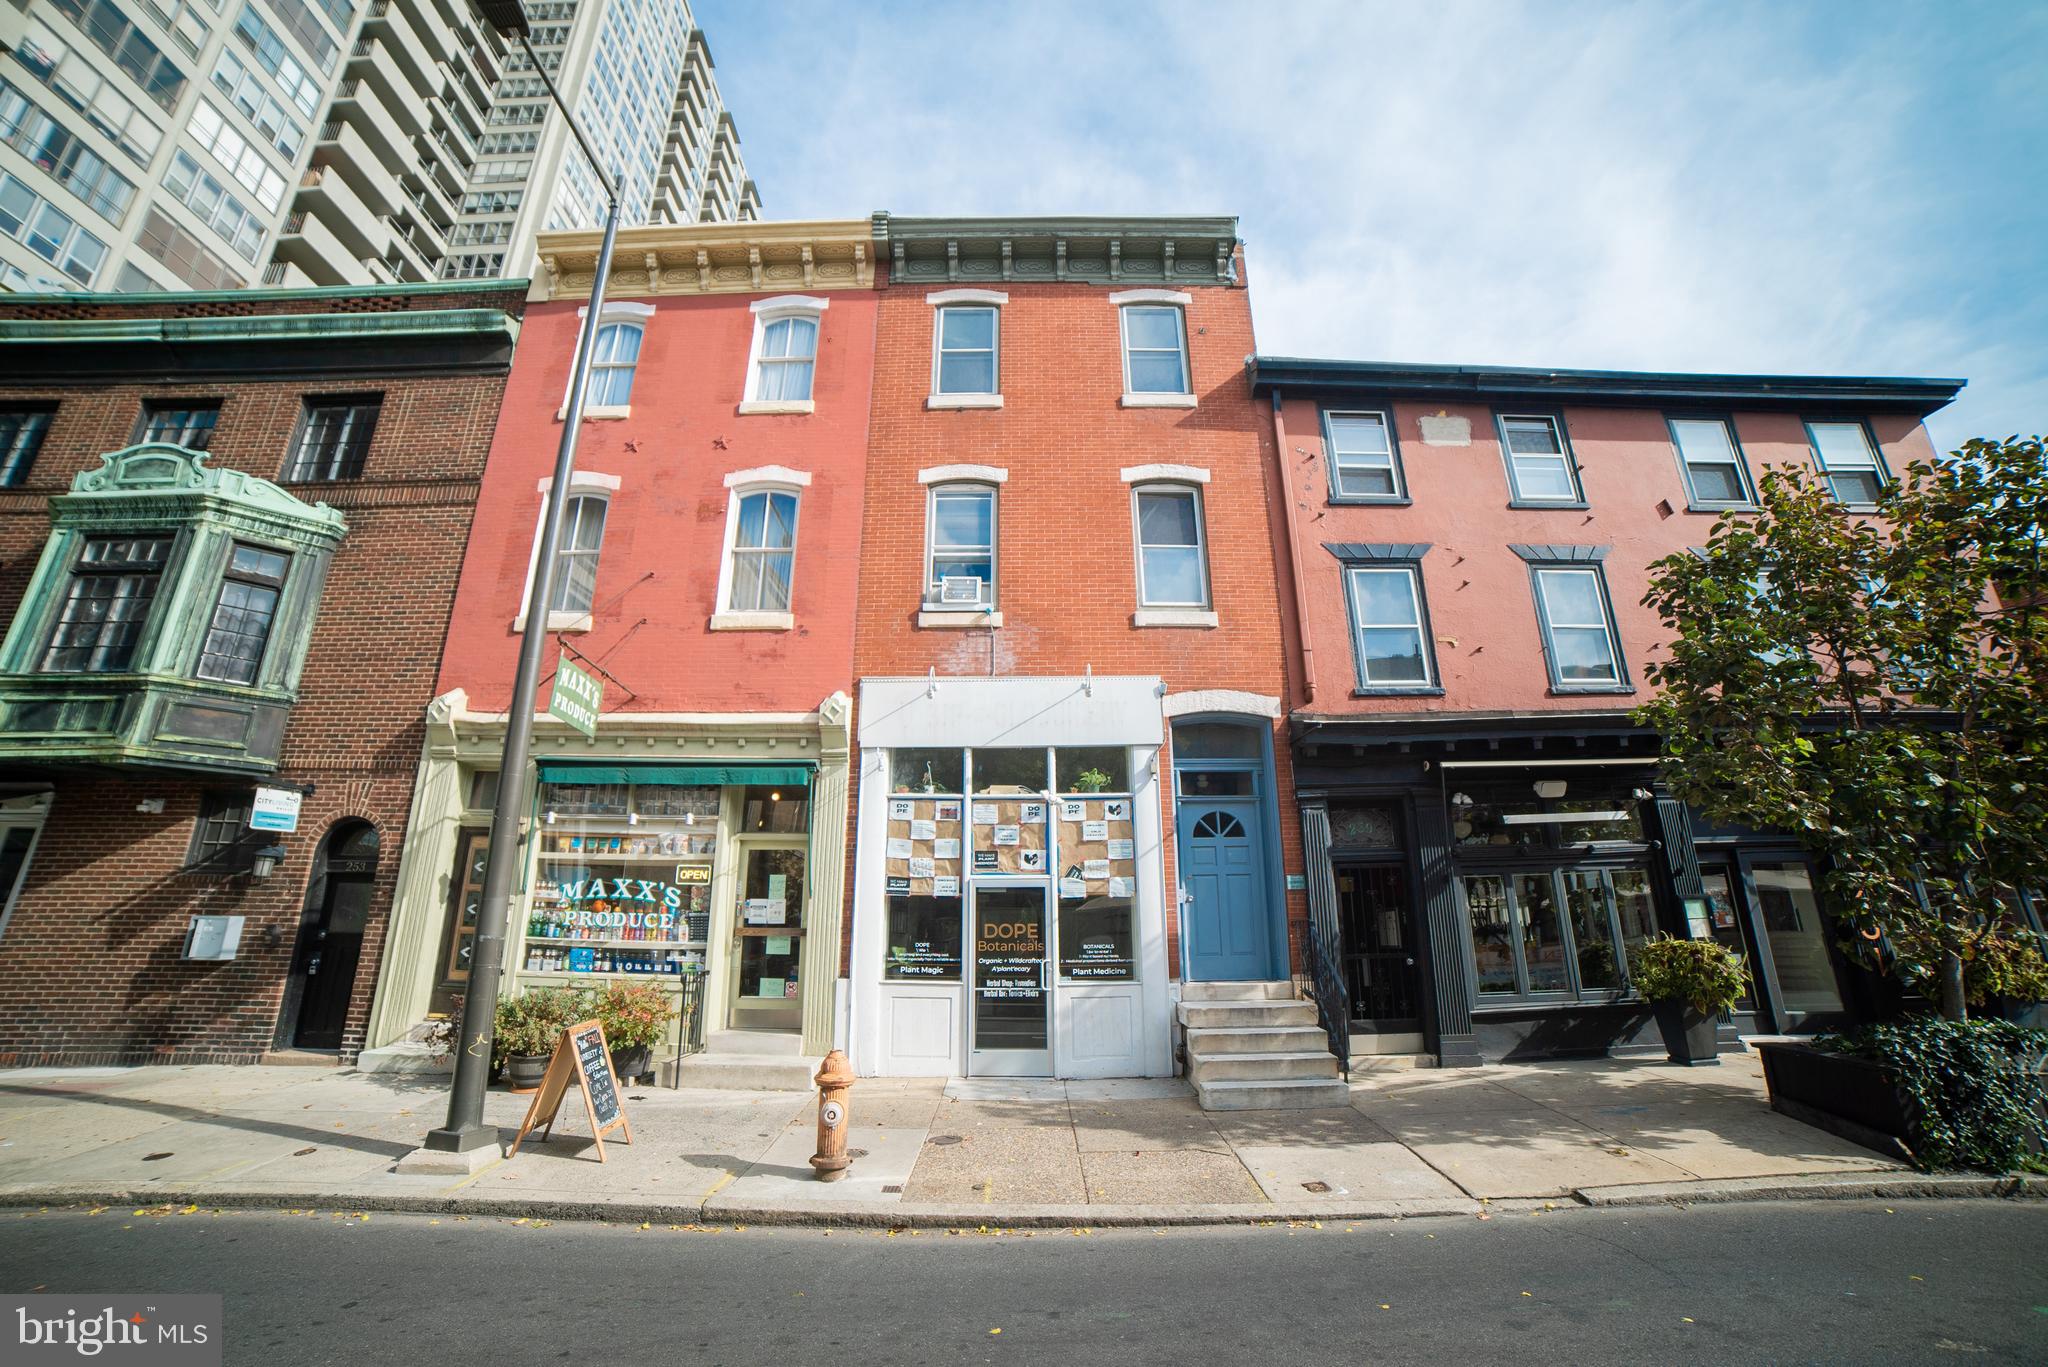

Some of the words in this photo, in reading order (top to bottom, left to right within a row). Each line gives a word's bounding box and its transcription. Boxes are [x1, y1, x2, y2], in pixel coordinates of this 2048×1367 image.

[559, 667, 600, 709] MAXX'S
[553, 691, 597, 729] PRODUCE
[679, 869, 709, 880] OPEN
[559, 877, 682, 909] MAXX'S
[561, 910, 675, 930] PRODUCE
[984, 923, 1039, 938] DOPE
[978, 940, 1045, 952] Botanicals
[921, 966, 944, 974] Magic
